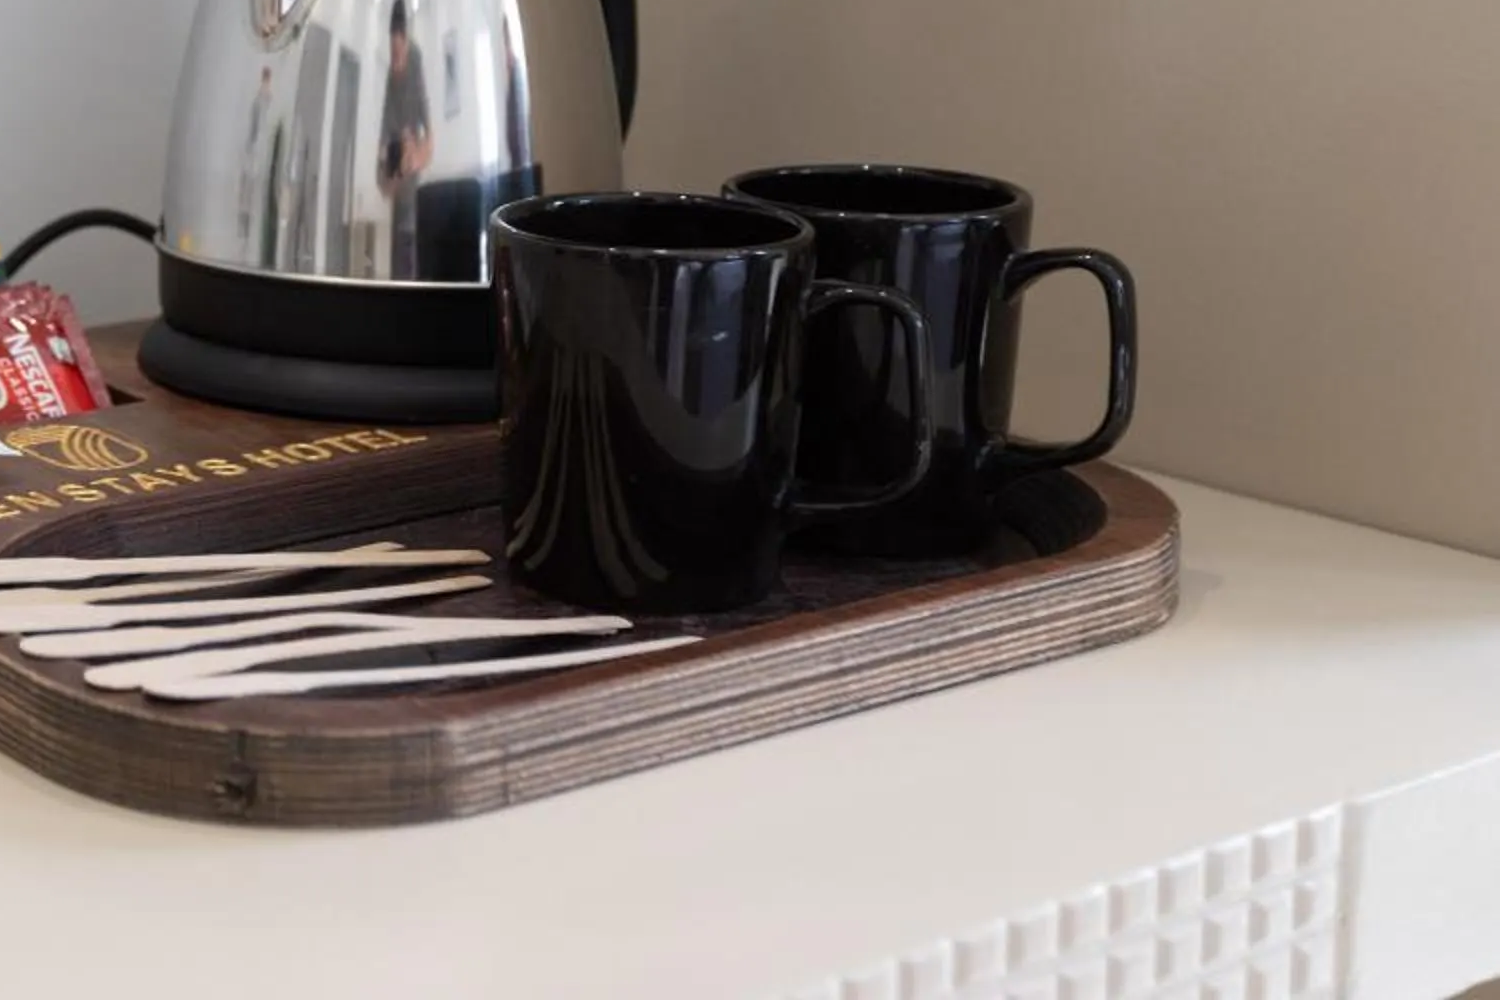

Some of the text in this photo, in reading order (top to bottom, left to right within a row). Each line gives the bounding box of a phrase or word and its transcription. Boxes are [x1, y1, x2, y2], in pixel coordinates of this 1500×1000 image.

[3, 333, 67, 418] NESCAF
[57, 457, 248, 503] STAYS
[243, 428, 428, 469] HOTEL
